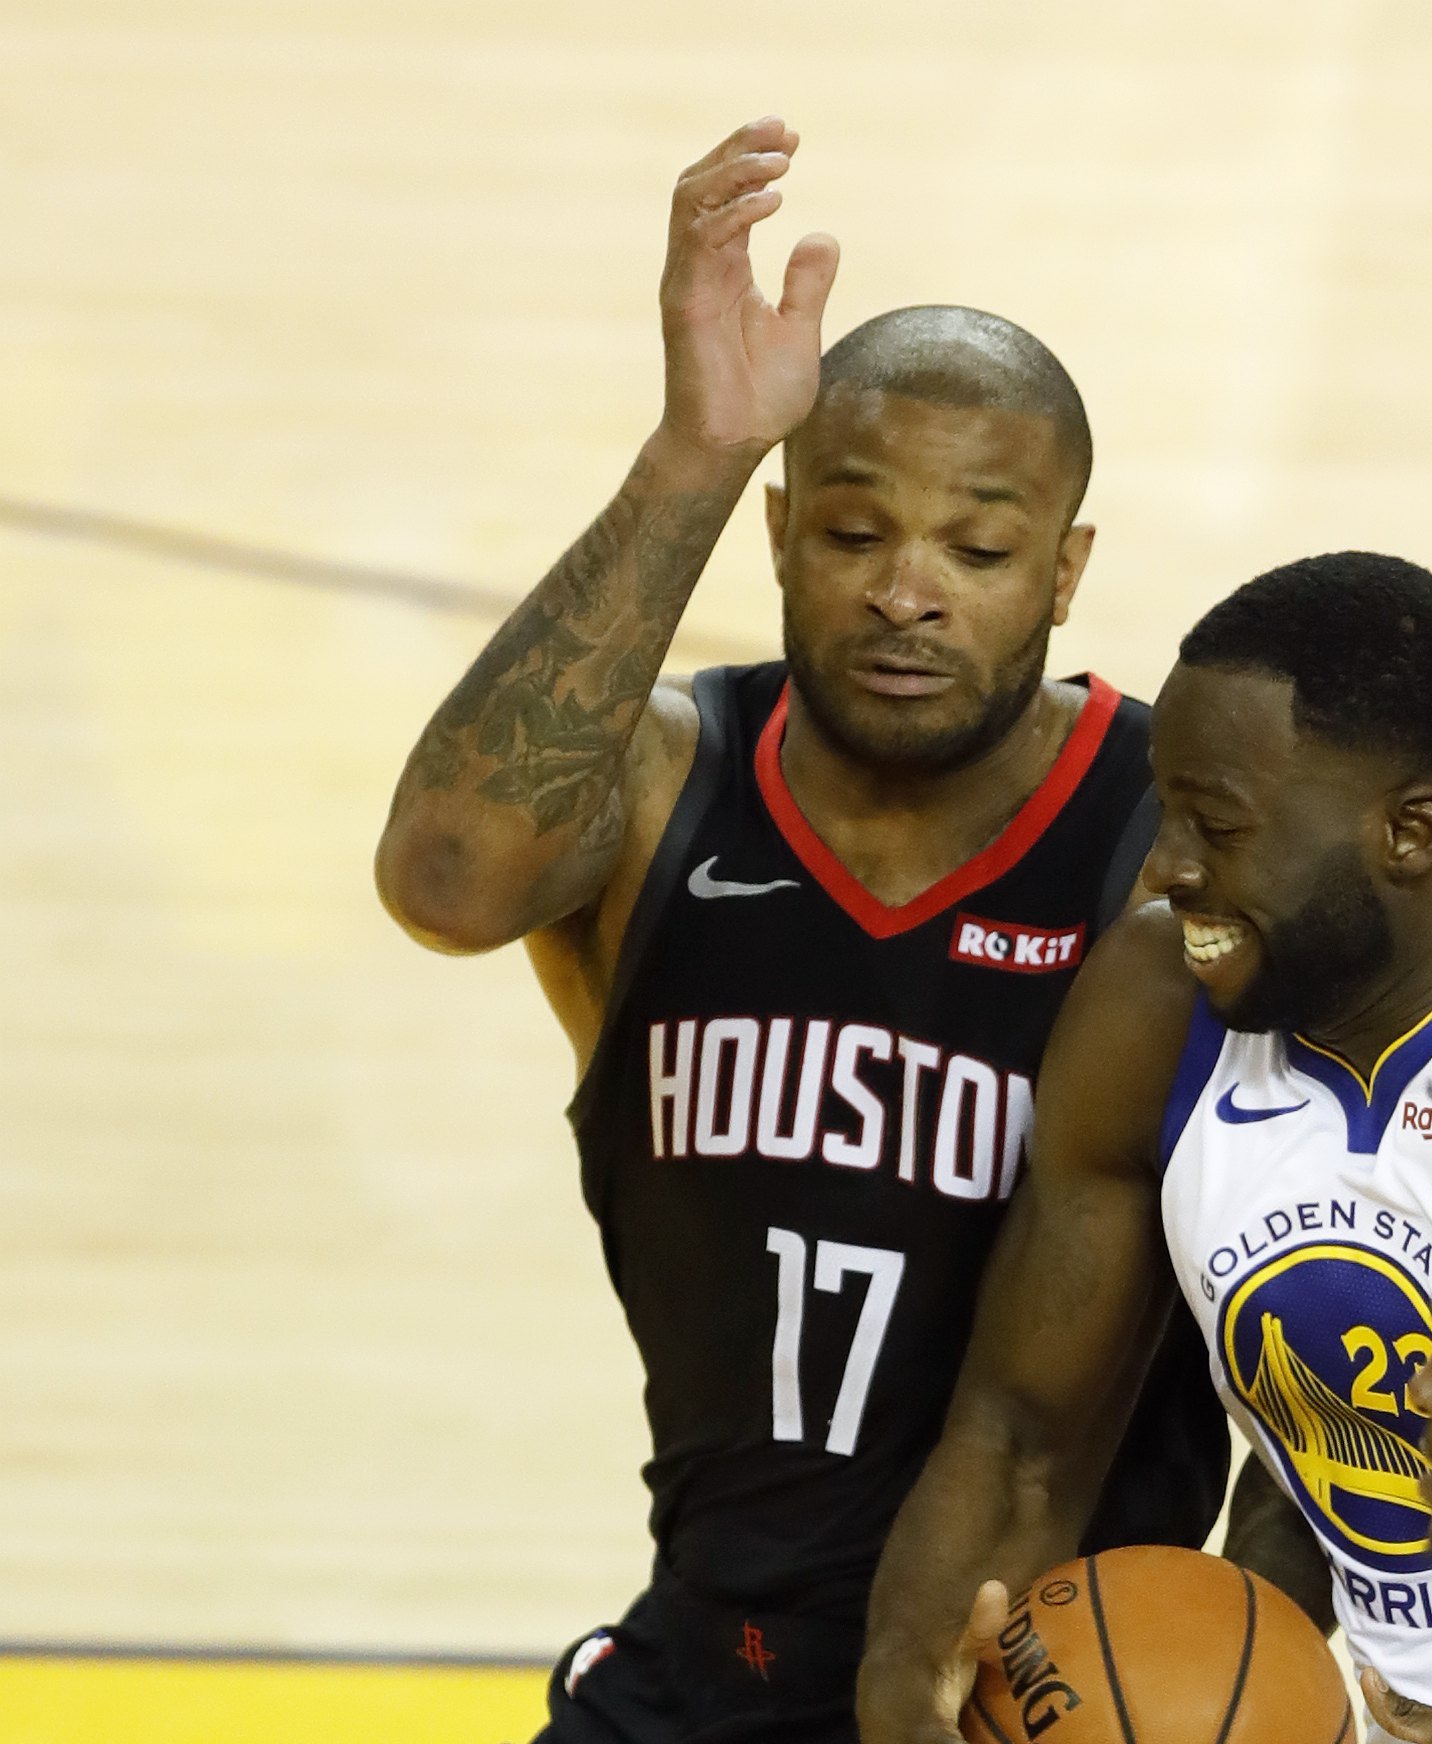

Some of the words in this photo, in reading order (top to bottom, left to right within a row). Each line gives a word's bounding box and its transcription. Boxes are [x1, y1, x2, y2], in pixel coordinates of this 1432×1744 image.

[1200, 1199, 1357, 1304] GOLDEN
[764, 1225, 906, 1457] 17
[997, 1594, 1083, 1742] DING
